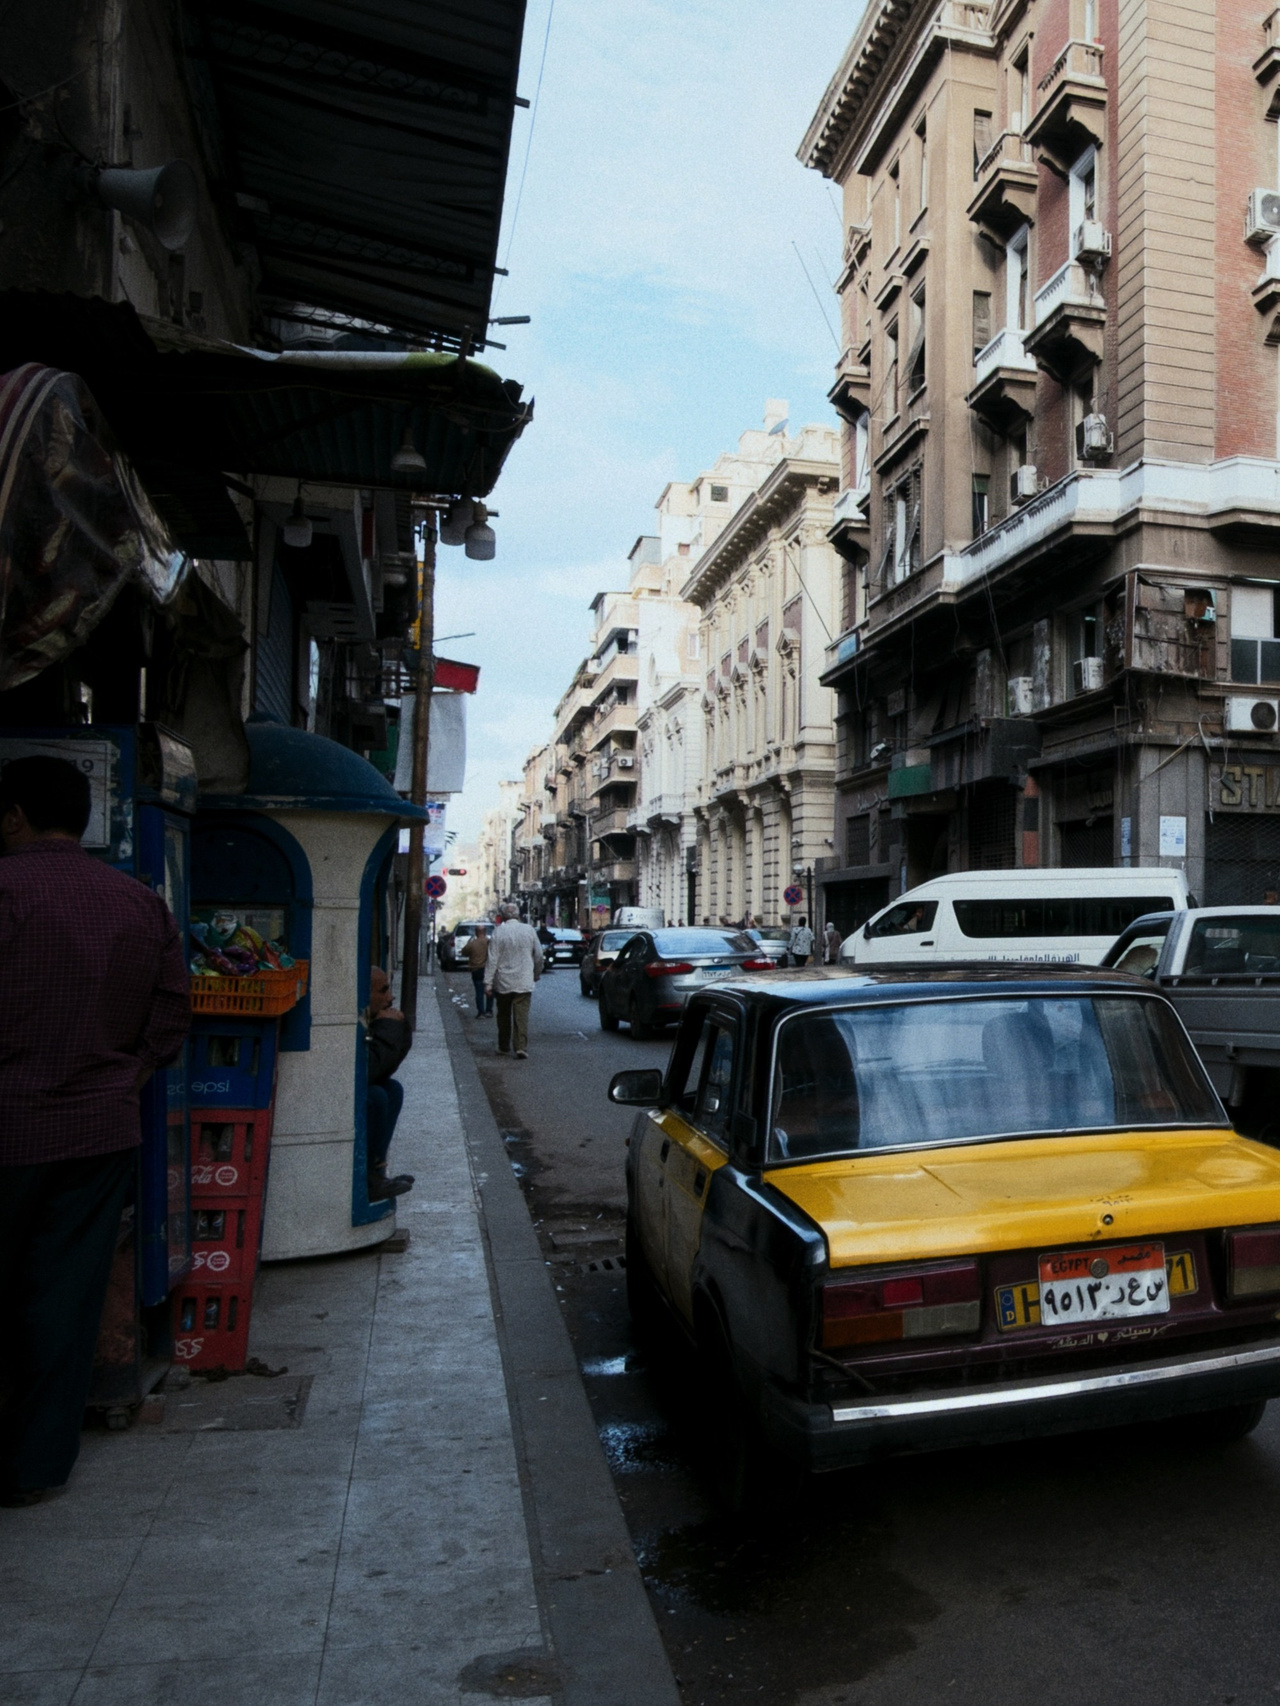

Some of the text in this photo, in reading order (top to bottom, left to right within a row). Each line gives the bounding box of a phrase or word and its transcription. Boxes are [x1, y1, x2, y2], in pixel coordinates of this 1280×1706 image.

[1051, 1257, 1090, 1275] EGYPT
[1117, 1251, 1151, 1266] مصر
[1005, 1310, 1016, 1322] D
